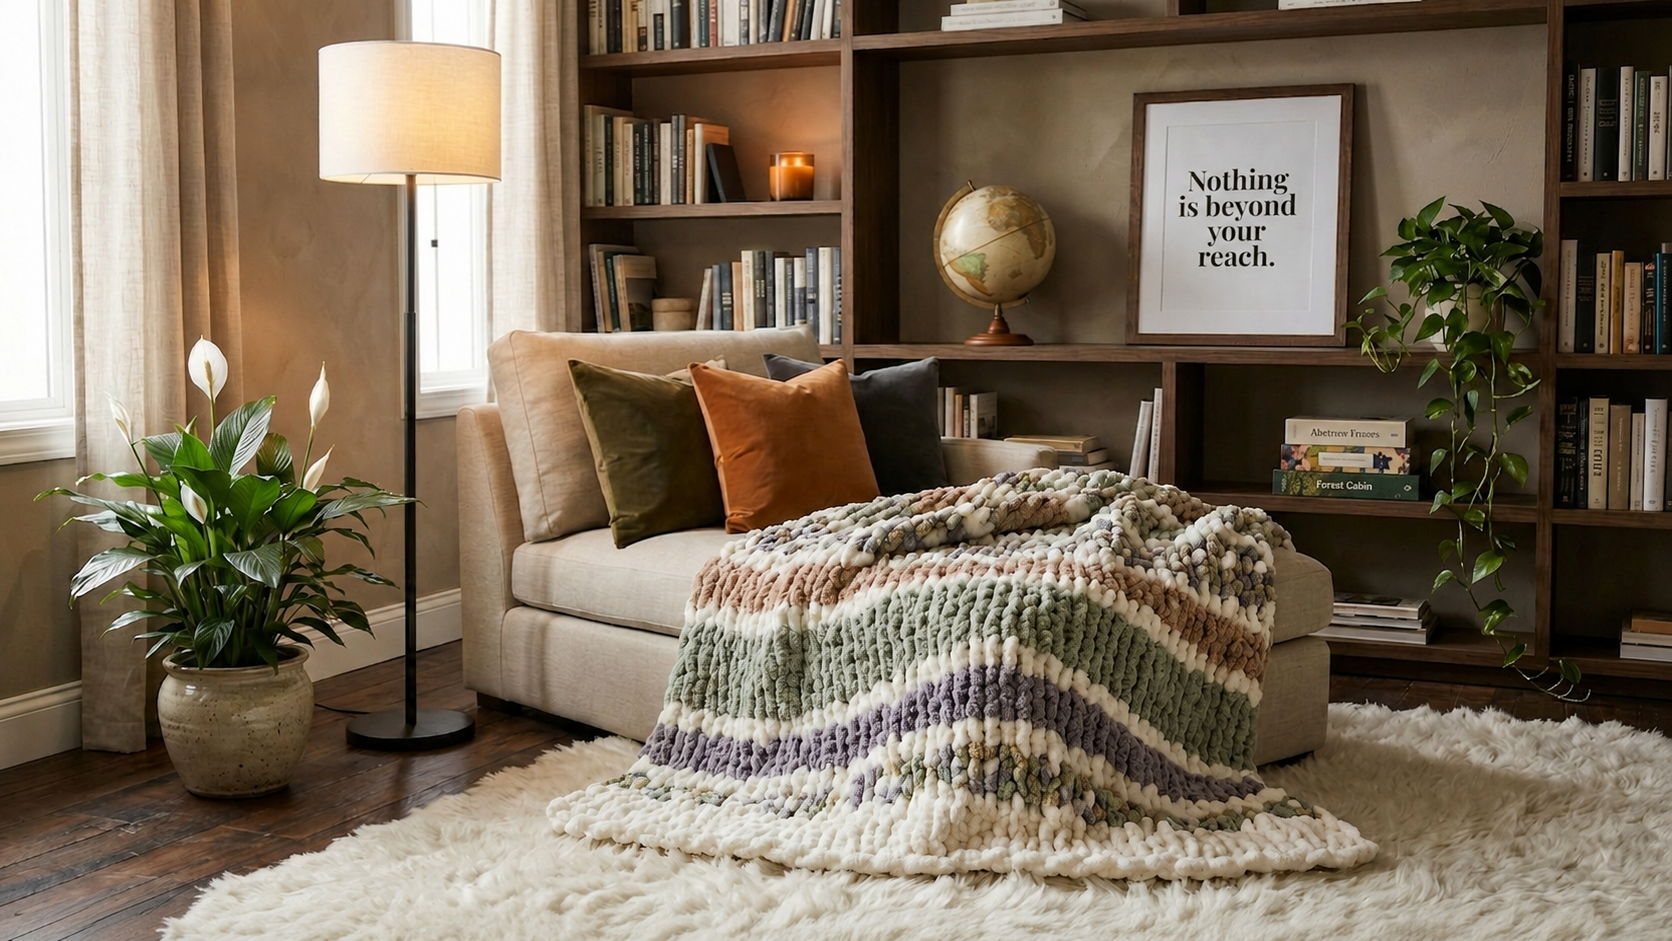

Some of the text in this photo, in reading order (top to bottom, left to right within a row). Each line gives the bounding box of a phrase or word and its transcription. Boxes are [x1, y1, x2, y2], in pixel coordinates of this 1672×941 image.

[1188, 168, 1290, 195] Nothing
[1179, 193, 1297, 221] is beyond
[1207, 225, 1266, 247] your
[1198, 245, 1275, 267] reach.
[1316, 480, 1373, 491] Forest Cabin
